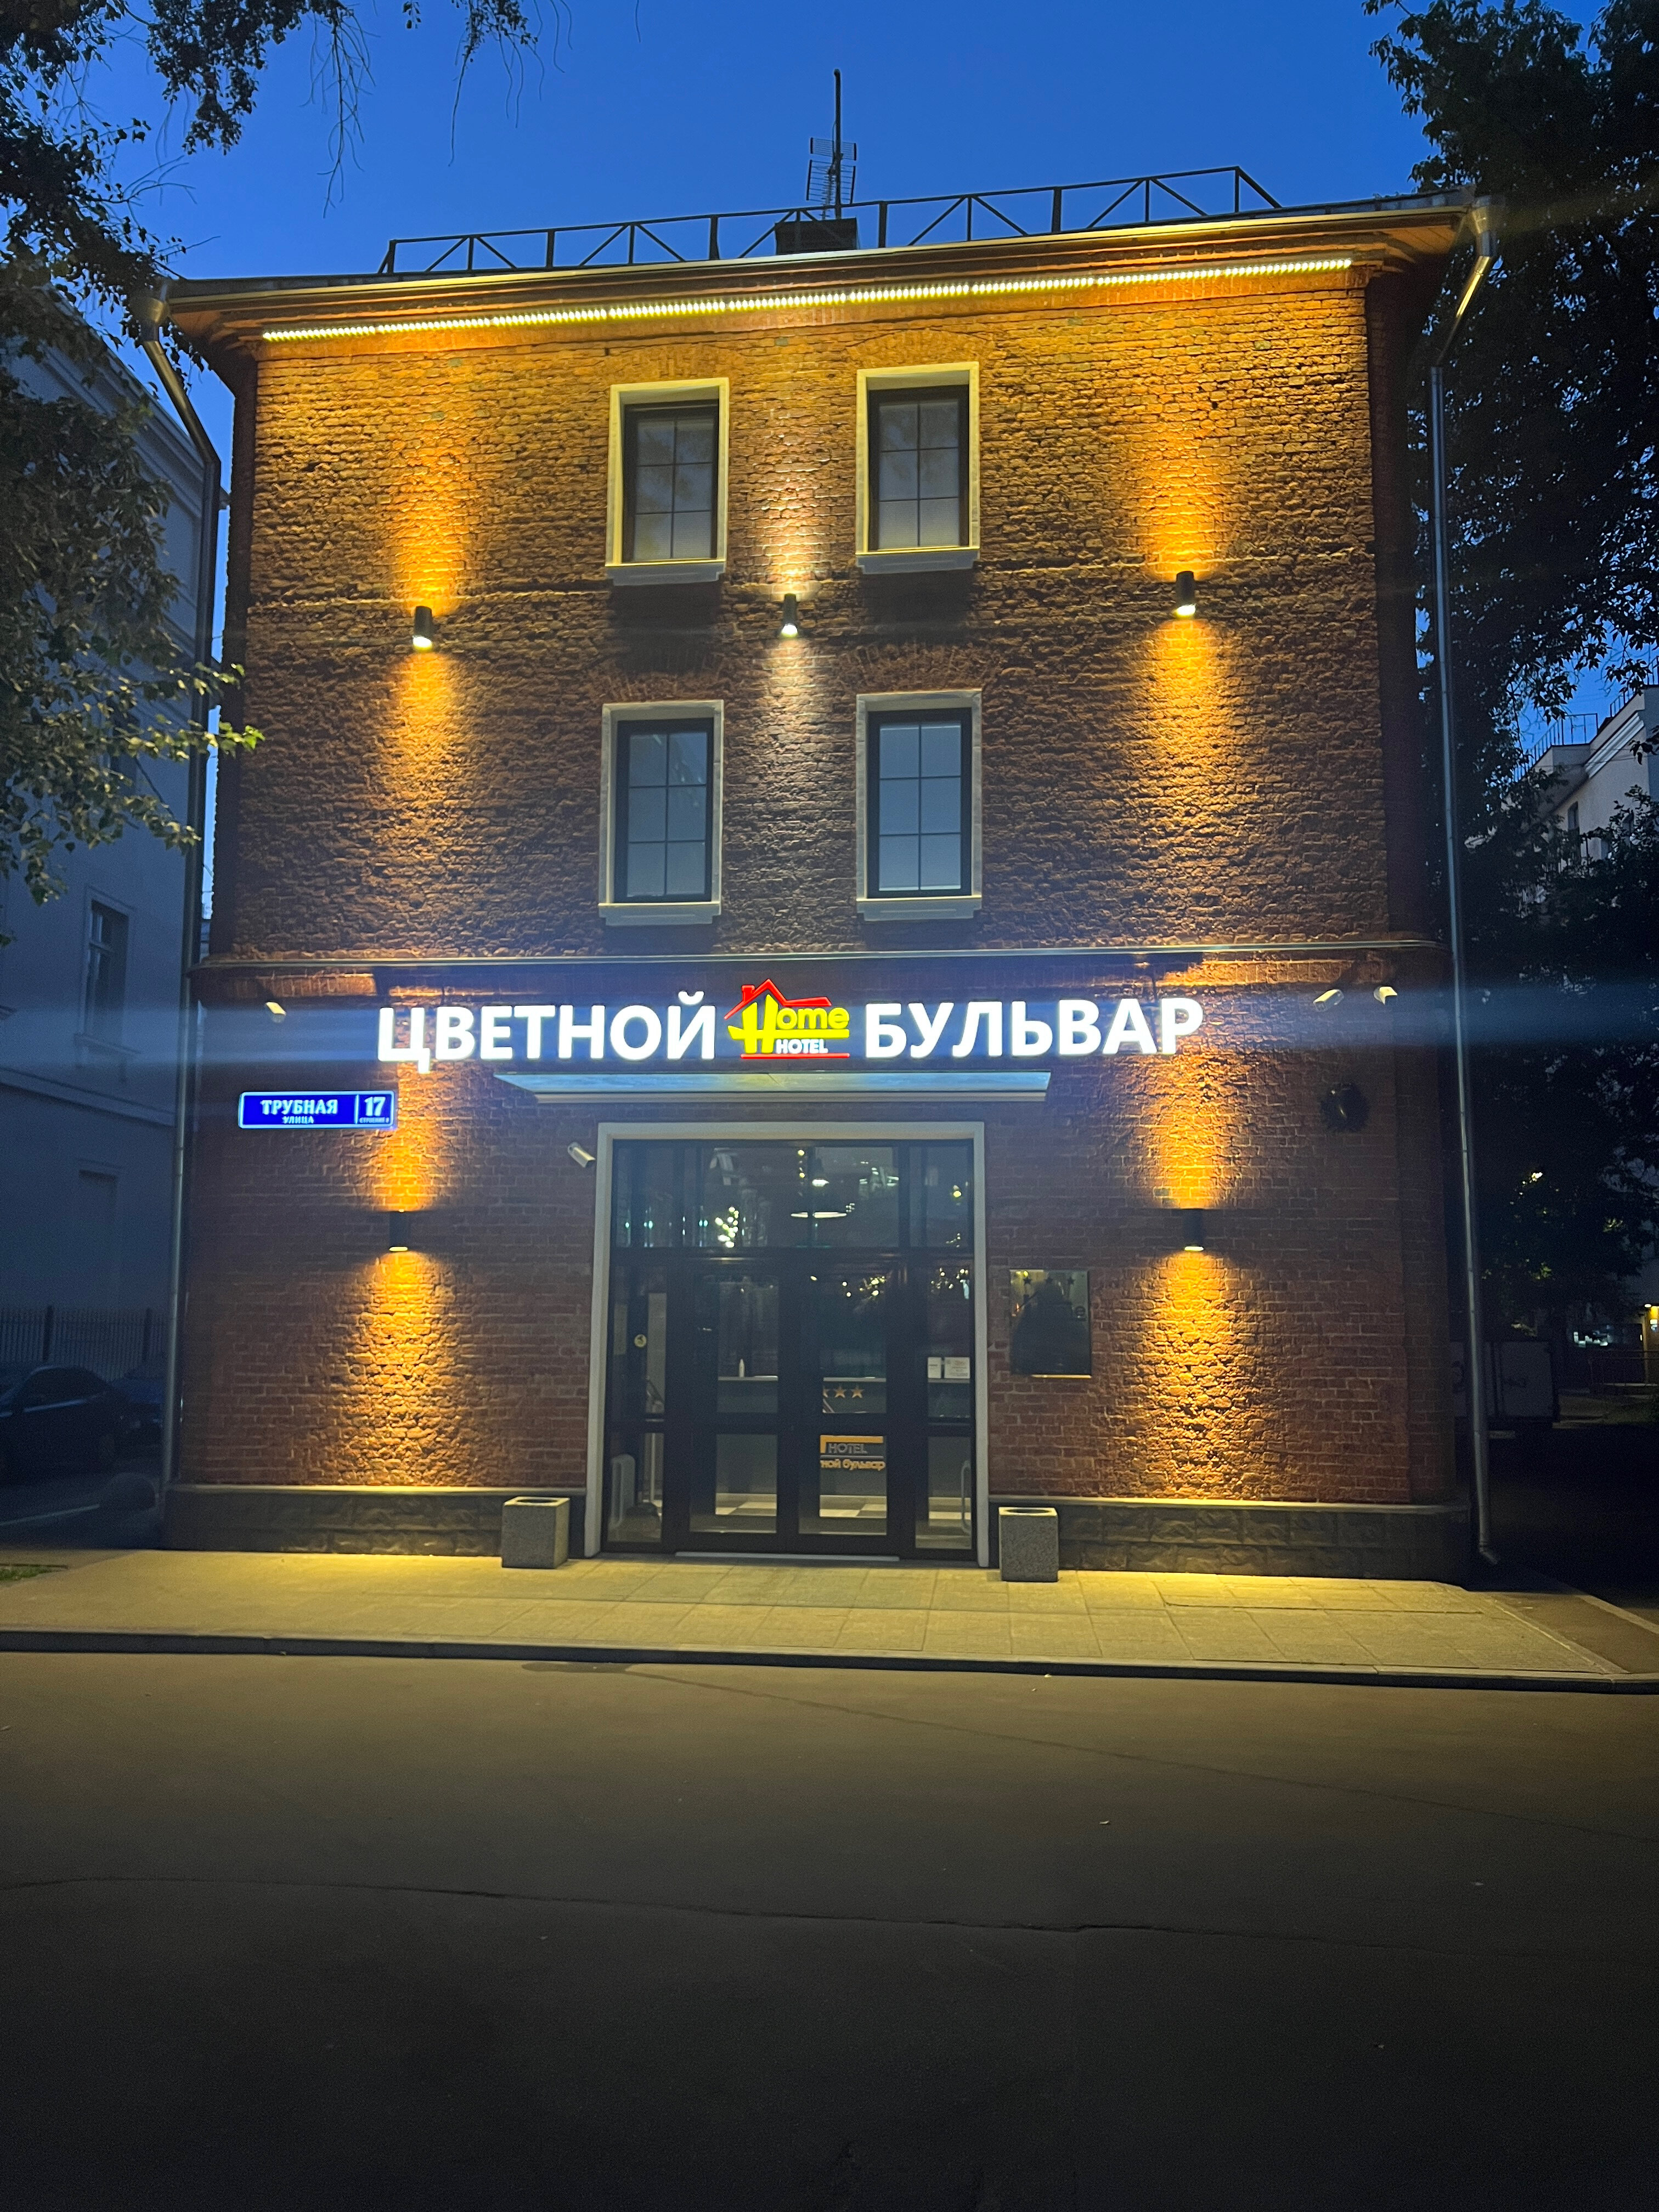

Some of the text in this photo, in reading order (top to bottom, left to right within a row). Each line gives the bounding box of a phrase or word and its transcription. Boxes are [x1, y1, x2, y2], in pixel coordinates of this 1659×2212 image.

[728, 994, 849, 1054] Home
[377, 990, 1204, 1074] ЦВЕТНОЙ БУЛЬВАР
[775, 1039, 828, 1054] HOTEL
[260, 1099, 338, 1115] ТРУБНАЯ
[364, 1096, 386, 1116] 17
[281, 1115, 314, 1124] УЛИЦА
[828, 1443, 868, 1454] HOTEL
[820, 1459, 886, 1471] ной бульвар
